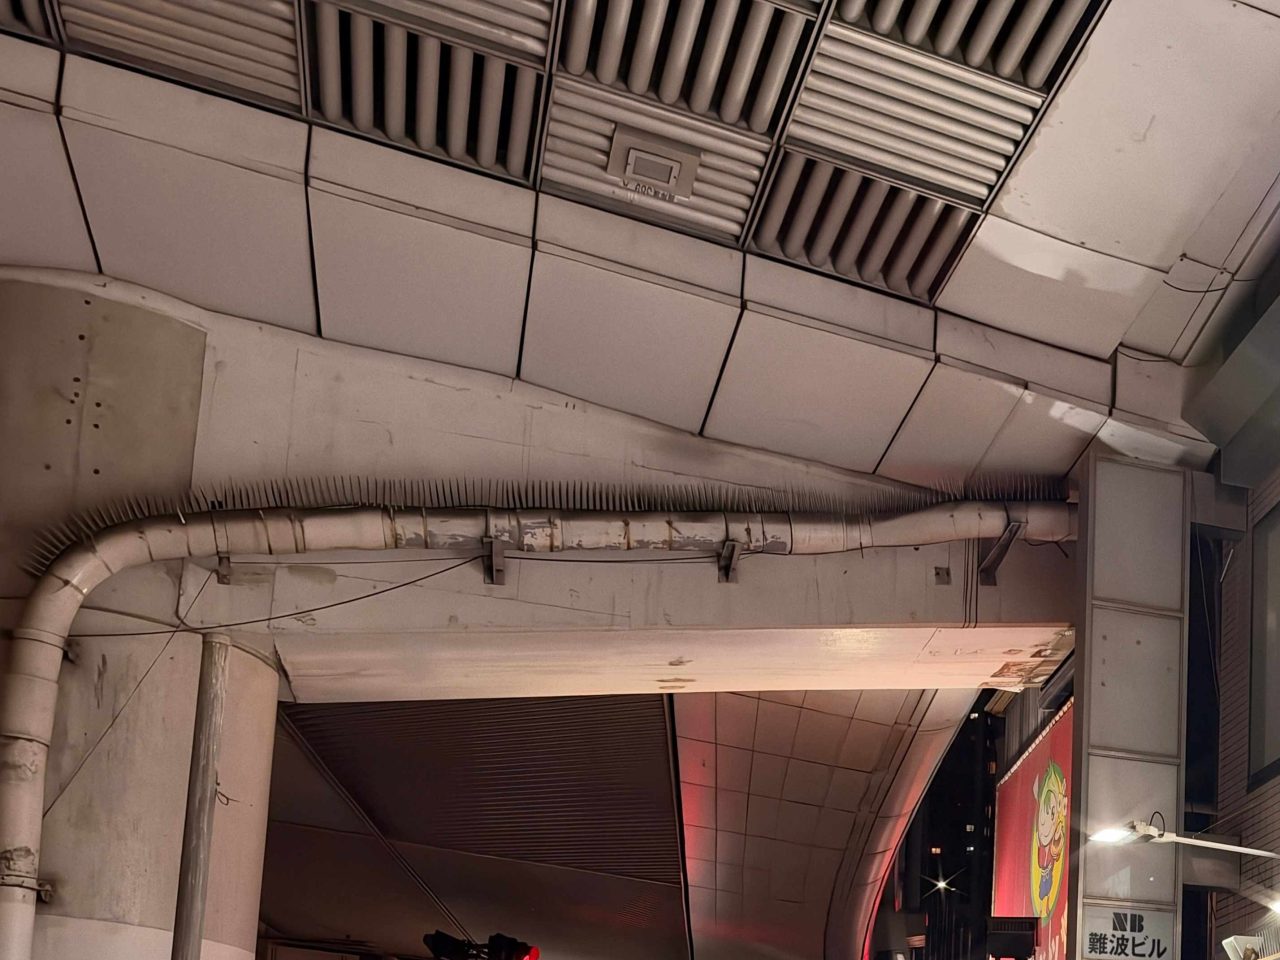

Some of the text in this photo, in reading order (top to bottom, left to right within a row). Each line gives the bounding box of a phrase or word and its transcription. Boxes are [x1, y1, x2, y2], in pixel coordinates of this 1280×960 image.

[1112, 911, 1144, 933] NB
[1088, 932, 1168, 959] 難波ビル
